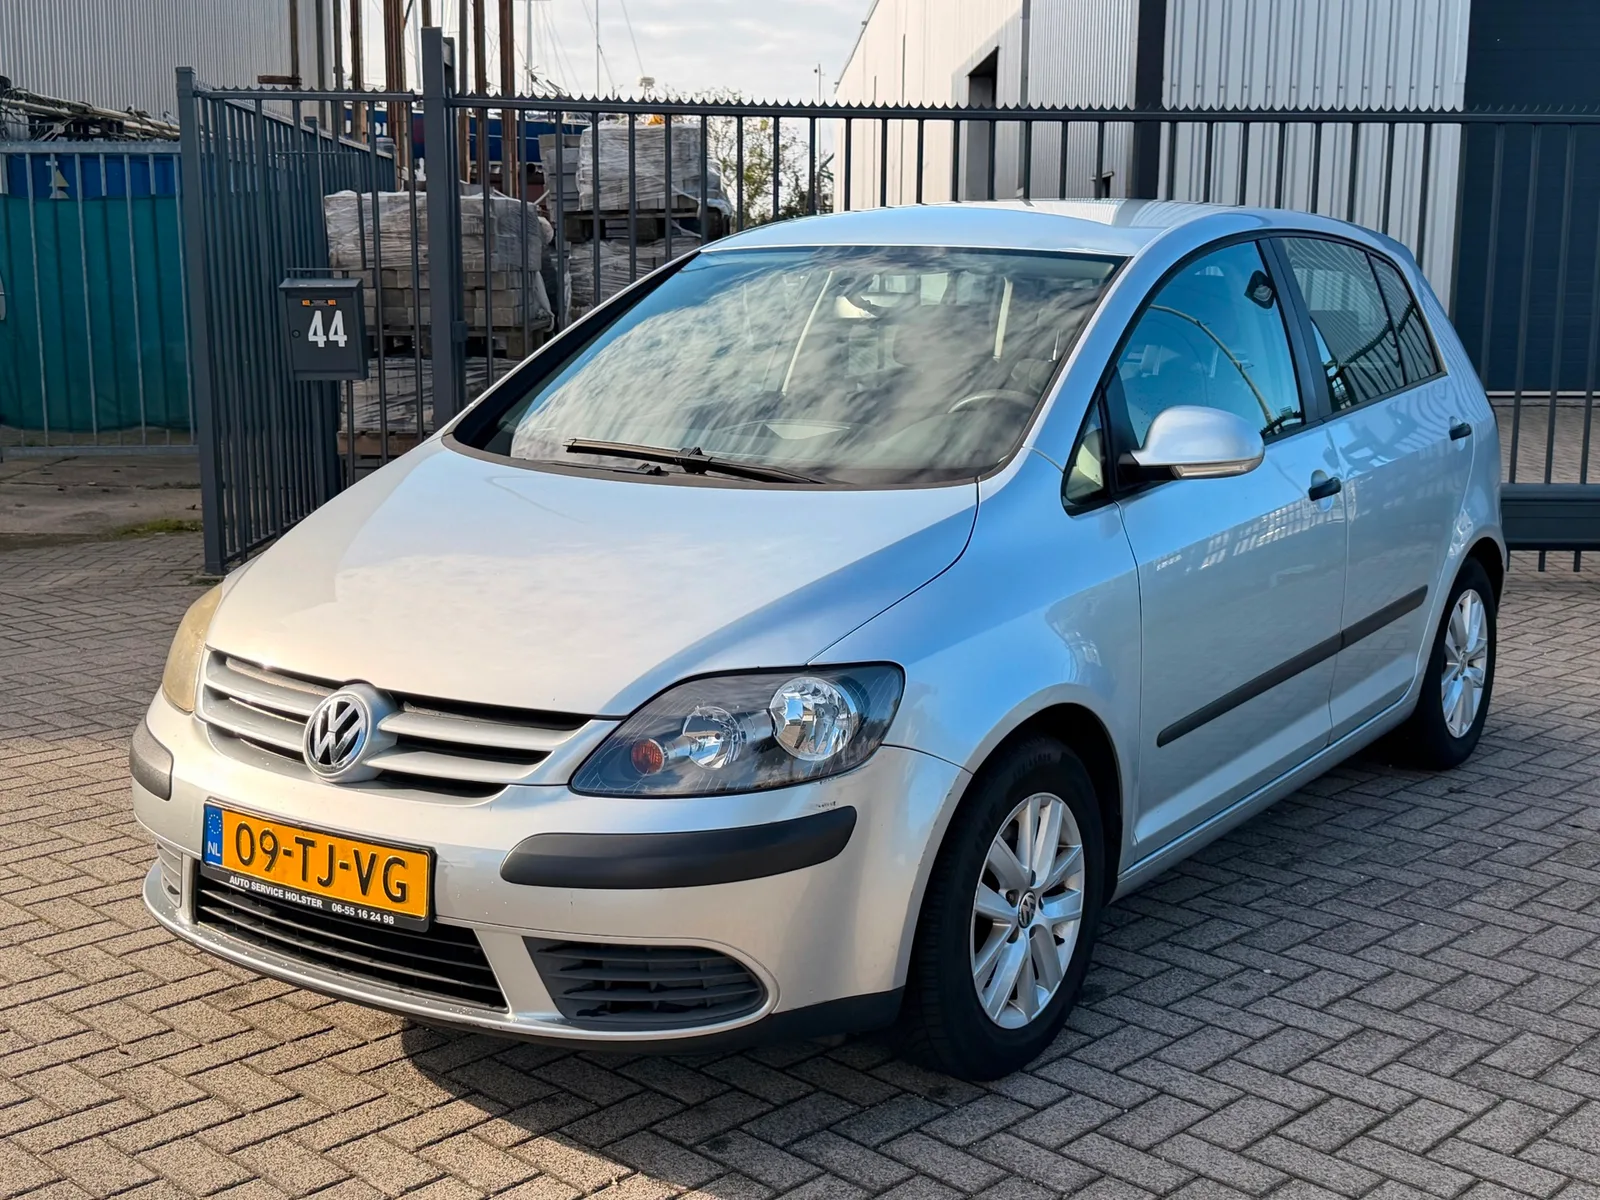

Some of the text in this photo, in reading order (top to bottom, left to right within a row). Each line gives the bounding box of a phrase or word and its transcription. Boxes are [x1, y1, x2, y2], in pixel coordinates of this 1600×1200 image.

[308, 310, 348, 348] 44
[207, 841, 221, 857] NL
[235, 822, 408, 903] 09-TJ-VG
[229, 875, 394, 925] AUTO SERVICE HOLSTER 06-55 16 24 98
